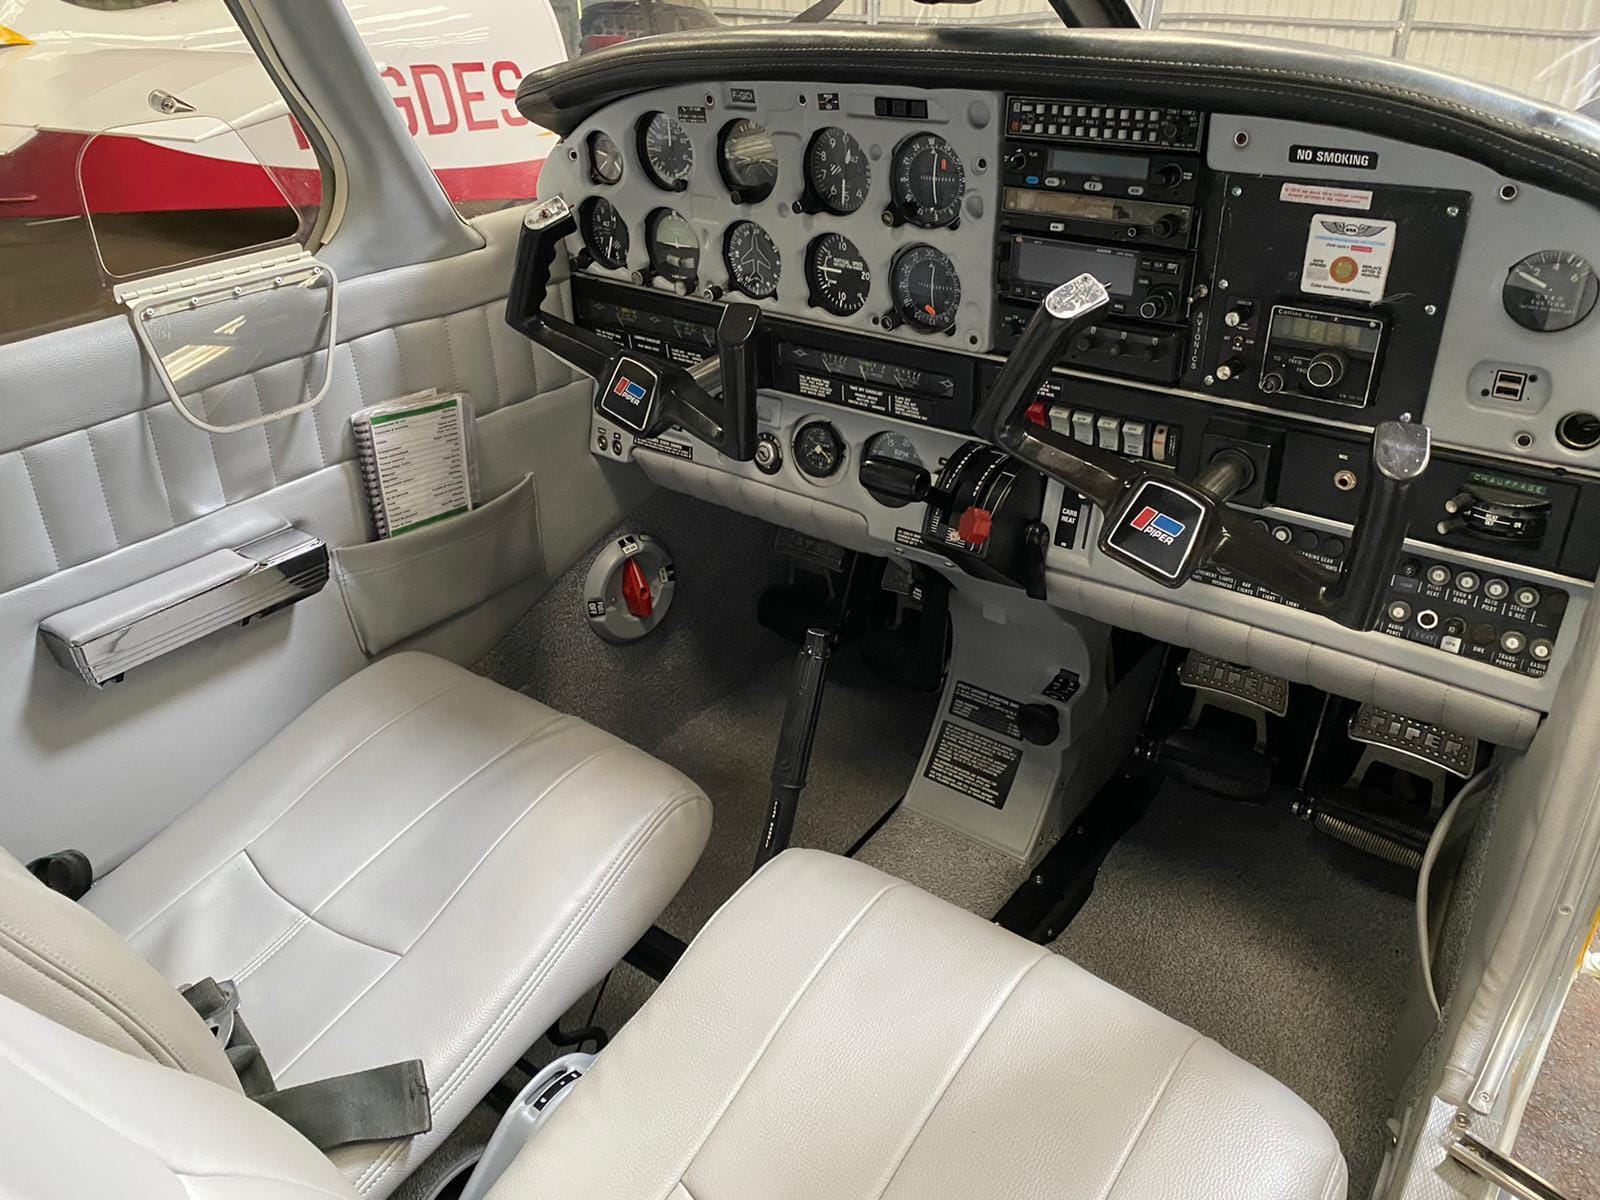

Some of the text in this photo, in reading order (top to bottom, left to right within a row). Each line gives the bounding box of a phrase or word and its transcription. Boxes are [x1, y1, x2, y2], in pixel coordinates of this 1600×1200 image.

[1296, 149, 1370, 166] NO SMOKING
[838, 242, 847, 251] 10
[1534, 268, 1541, 276] 2
[1552, 263, 1560, 272] 4
[861, 271, 871, 281] 20
[1570, 273, 1578, 282] 6
[838, 291, 847, 301] 10
[1191, 312, 1203, 370] AVIONICS
[621, 391, 641, 406] PIPER
[887, 439, 895, 447] 15
[893, 449, 909, 458] RPM
[1474, 473, 1544, 494] CHAUFFAGE
[1062, 508, 1078, 518] CARB
[1061, 515, 1076, 524] HEAT
[1143, 526, 1174, 546] PIPER
[1320, 556, 1334, 564] GEAR
[1236, 586, 1254, 595] LIGHTS
[1426, 590, 1440, 598] HEAT
[1452, 589, 1466, 598] TURN
[1453, 597, 1468, 605] BANK
[1484, 597, 1498, 605] AUTO
[589, 602, 597, 615] OFF
[1481, 603, 1497, 612] PILOT
[1510, 604, 1527, 613] START
[1388, 622, 1404, 631] AUDIO
[1385, 628, 1402, 637] PANEL
[1472, 646, 1485, 654] DME
[1495, 659, 1516, 668] PONDER
[1529, 661, 1546, 670] RADIO
[1197, 661, 1276, 697] PIPER
[1369, 714, 1462, 757] PIPER
